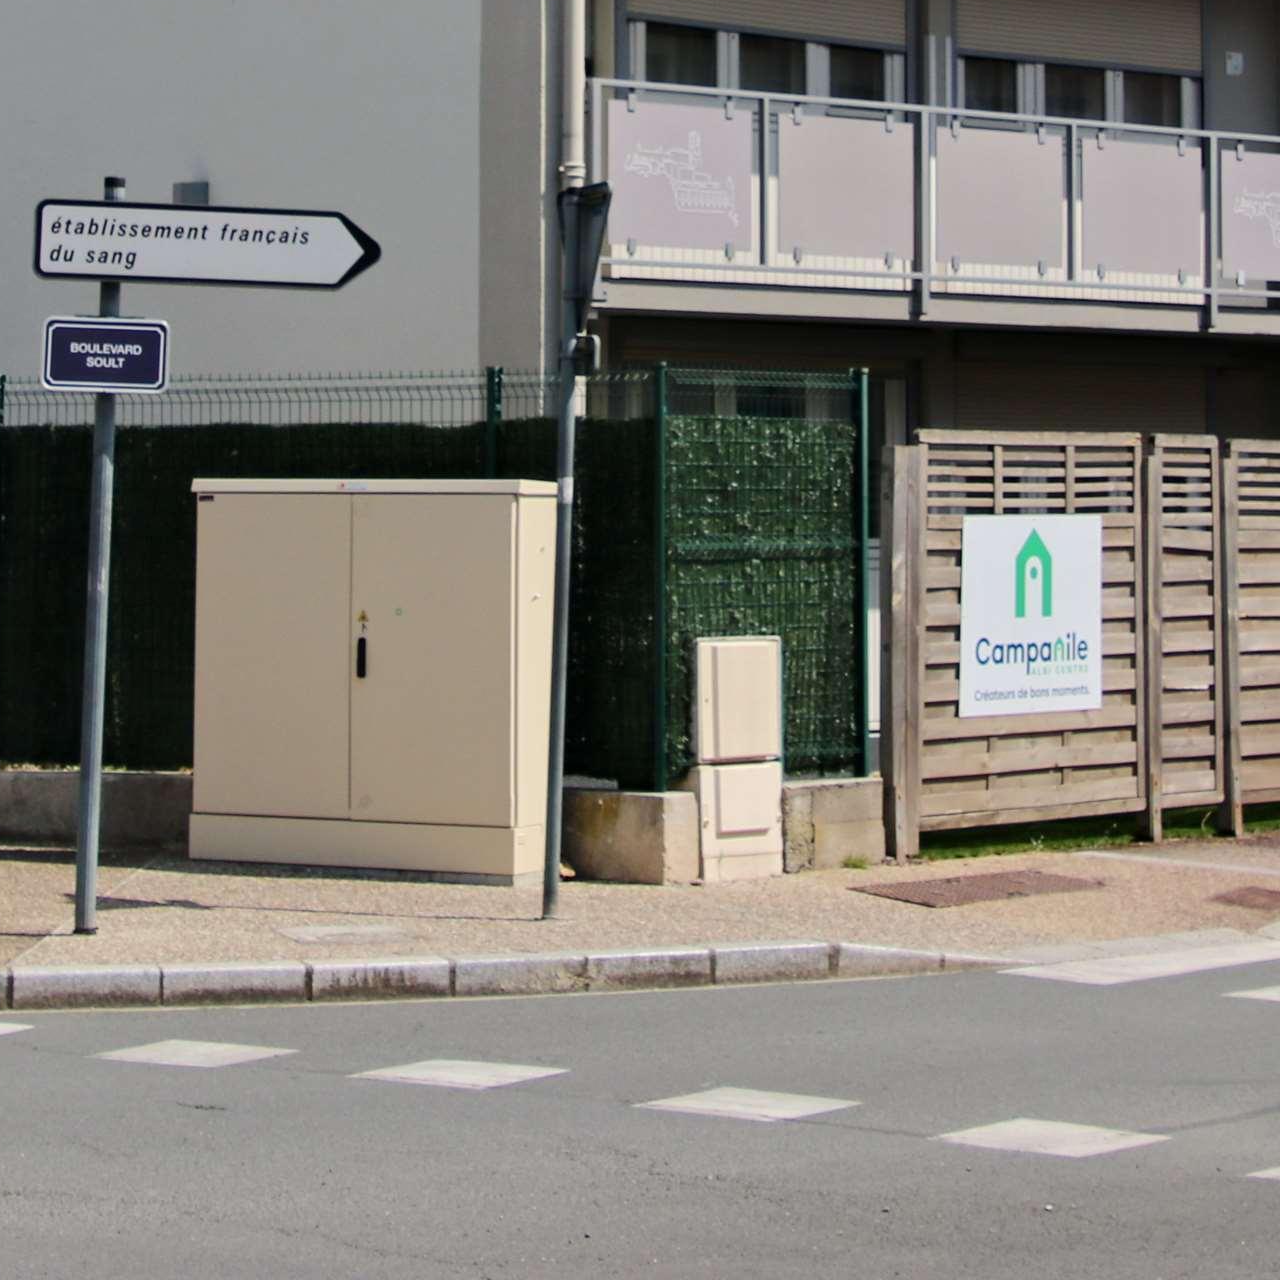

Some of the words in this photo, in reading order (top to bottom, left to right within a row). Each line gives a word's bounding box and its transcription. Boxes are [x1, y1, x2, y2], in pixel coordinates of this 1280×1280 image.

[51, 217, 208, 240] établissement
[221, 223, 310, 245] français
[50, 245, 74, 262] du
[86, 250, 137, 269] sang
[70, 342, 142, 355] BOULEVARD
[86, 356, 125, 368] SOULT
[975, 632, 1088, 675] Campanile
